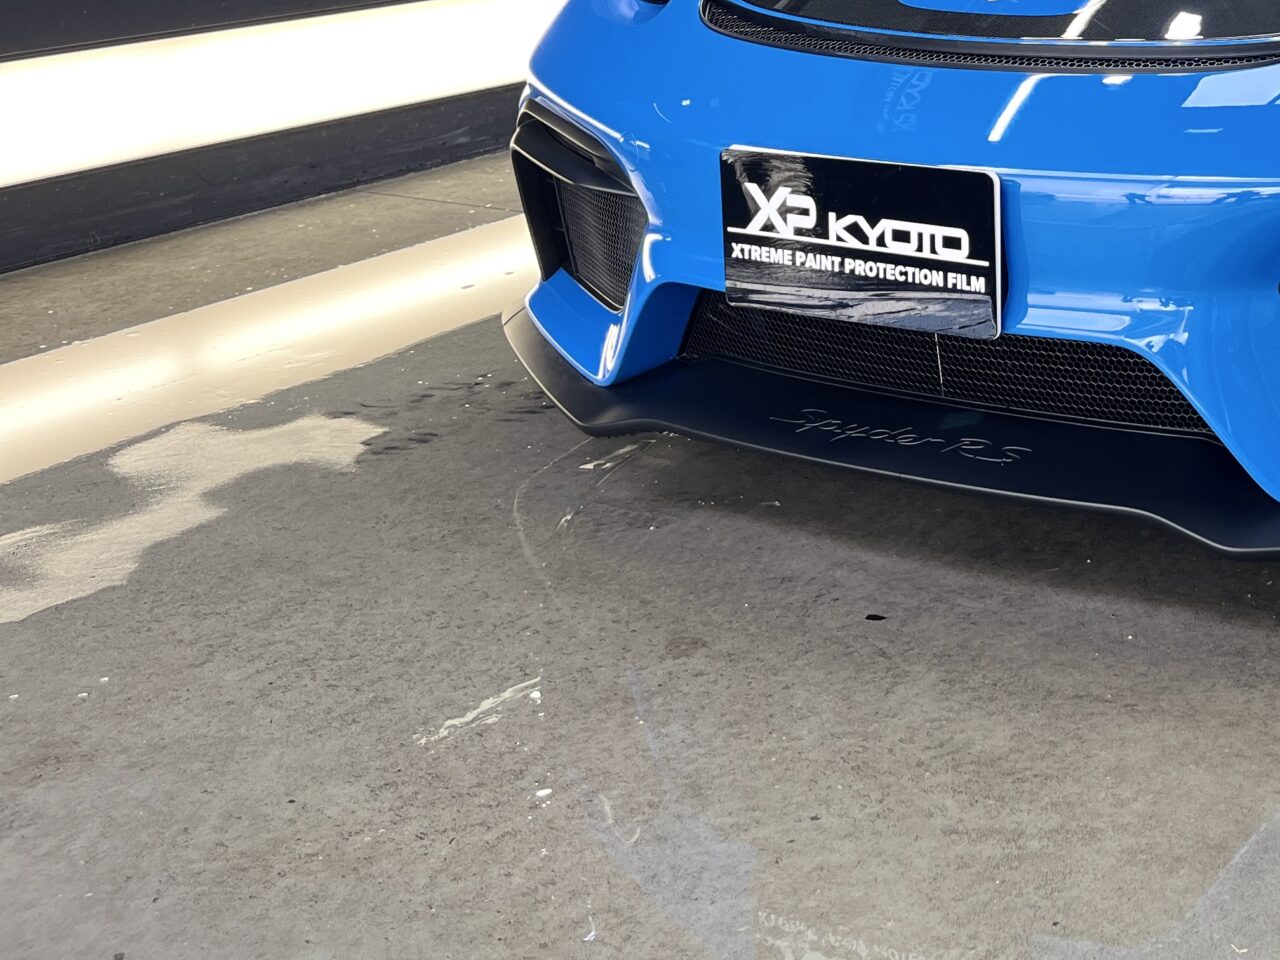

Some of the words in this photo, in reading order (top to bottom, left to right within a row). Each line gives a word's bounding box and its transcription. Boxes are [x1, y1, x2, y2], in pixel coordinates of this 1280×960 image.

[744, 182, 817, 237] XP
[828, 211, 969, 260] KYOTO
[731, 242, 793, 266] XTREME
[795, 251, 842, 274] PAINT
[844, 257, 944, 288] PROTECTION
[946, 271, 986, 294] FILM
